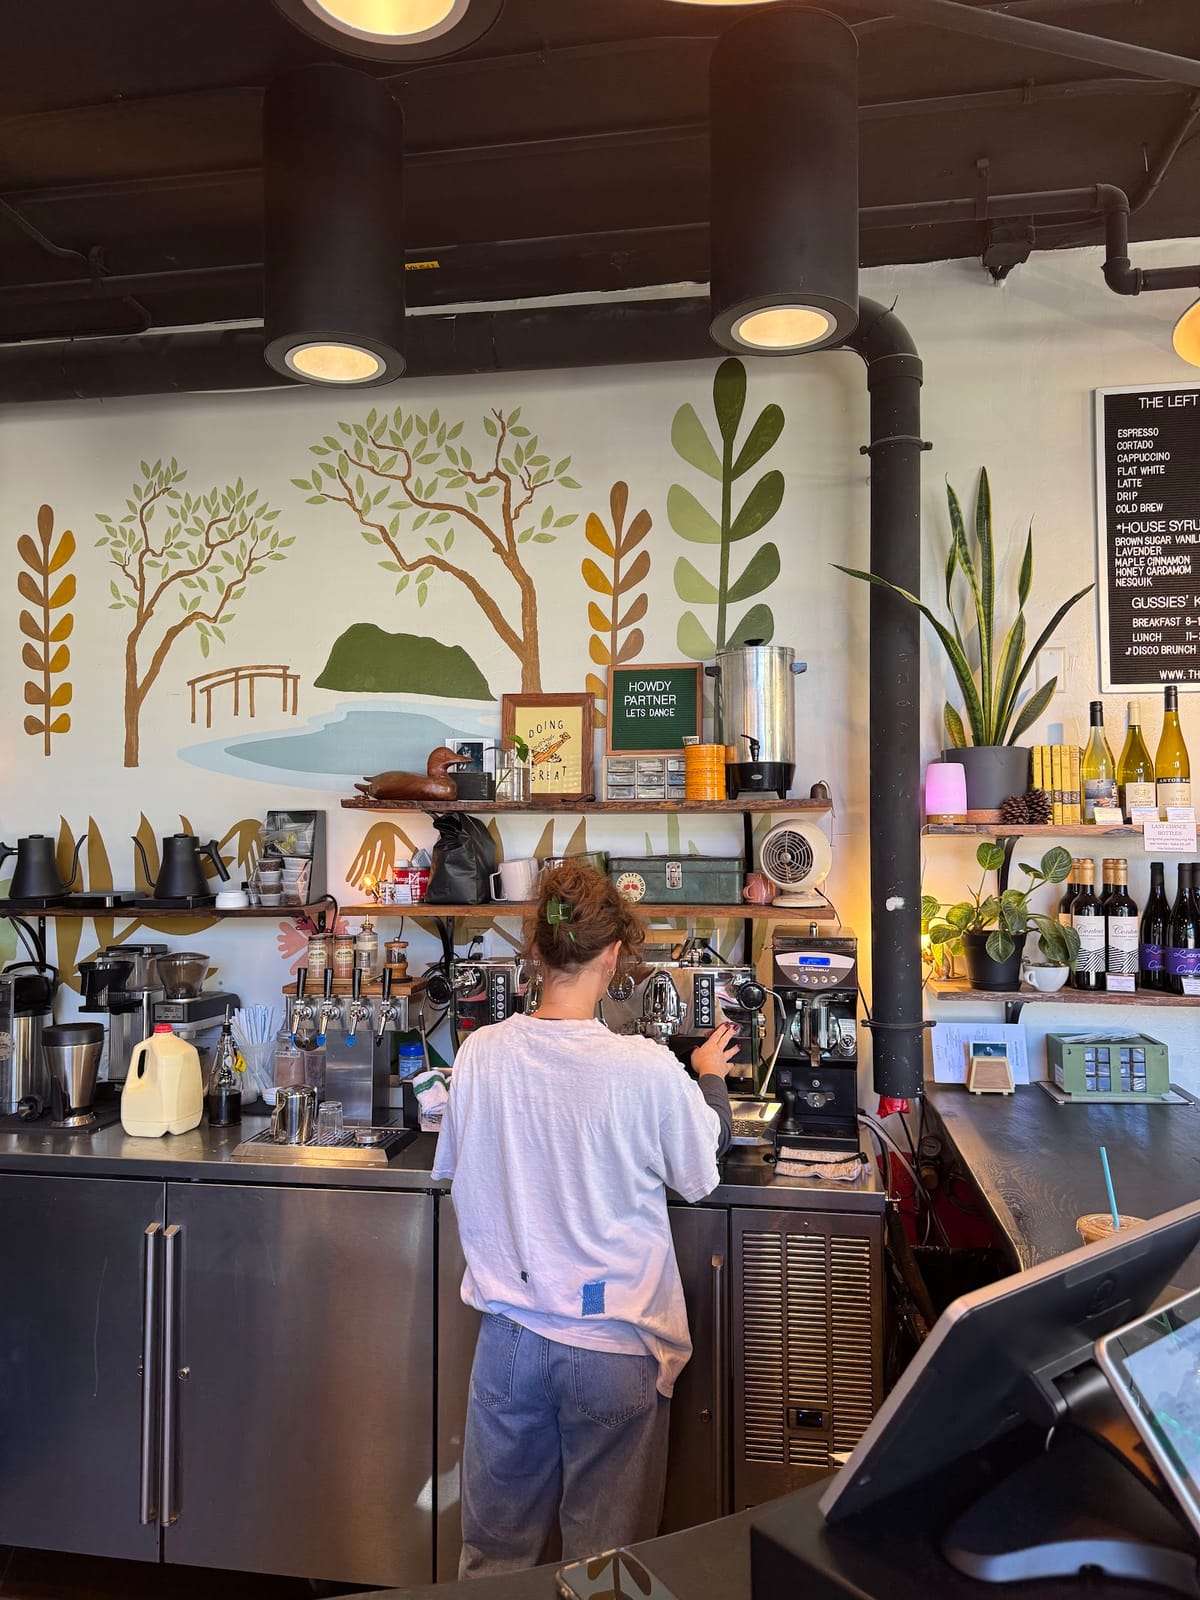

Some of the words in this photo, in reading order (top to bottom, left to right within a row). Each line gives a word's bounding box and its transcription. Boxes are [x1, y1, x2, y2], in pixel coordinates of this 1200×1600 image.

[1138, 396, 1164, 409] THE
[1167, 394, 1199, 408] LEFT
[1117, 427, 1159, 438] ESPRESSO
[1116, 440, 1154, 451] CORTADO
[1116, 451, 1171, 463] CAPPUCCINO
[1117, 466, 1138, 476] FLAT
[1140, 465, 1166, 475] WHITE
[1117, 478, 1143, 488] LATTE
[1116, 491, 1138, 501] DRIP
[1115, 503, 1138, 514] COLD
[1140, 502, 1164, 512] BREW
[1115, 536, 1144, 547] BROWN
[1144, 535, 1172, 545] SUGAR
[1115, 546, 1162, 557] LAVENDER
[1115, 557, 1145, 567] MAPLE
[1147, 555, 1191, 566] CINNAMON
[1115, 567, 1144, 577] HONEY
[1146, 565, 1192, 576] CARDAMOM
[1115, 577, 1153, 587] NESQUIK
[1131, 595, 1189, 609] GUSSIES'
[1132, 616, 1181, 628] BREAKFAST
[1132, 632, 1162, 642] LUNCH
[1132, 645, 1159, 655] DISCO
[1160, 644, 1197, 655] BRUNCH
[628, 680, 672, 692] HOWDY
[624, 694, 677, 705] PARTNER
[625, 708, 646, 718] LETS
[649, 707, 676, 717] DANCE
[528, 719, 564, 739] DOING
[530, 765, 567, 782] GREAT
